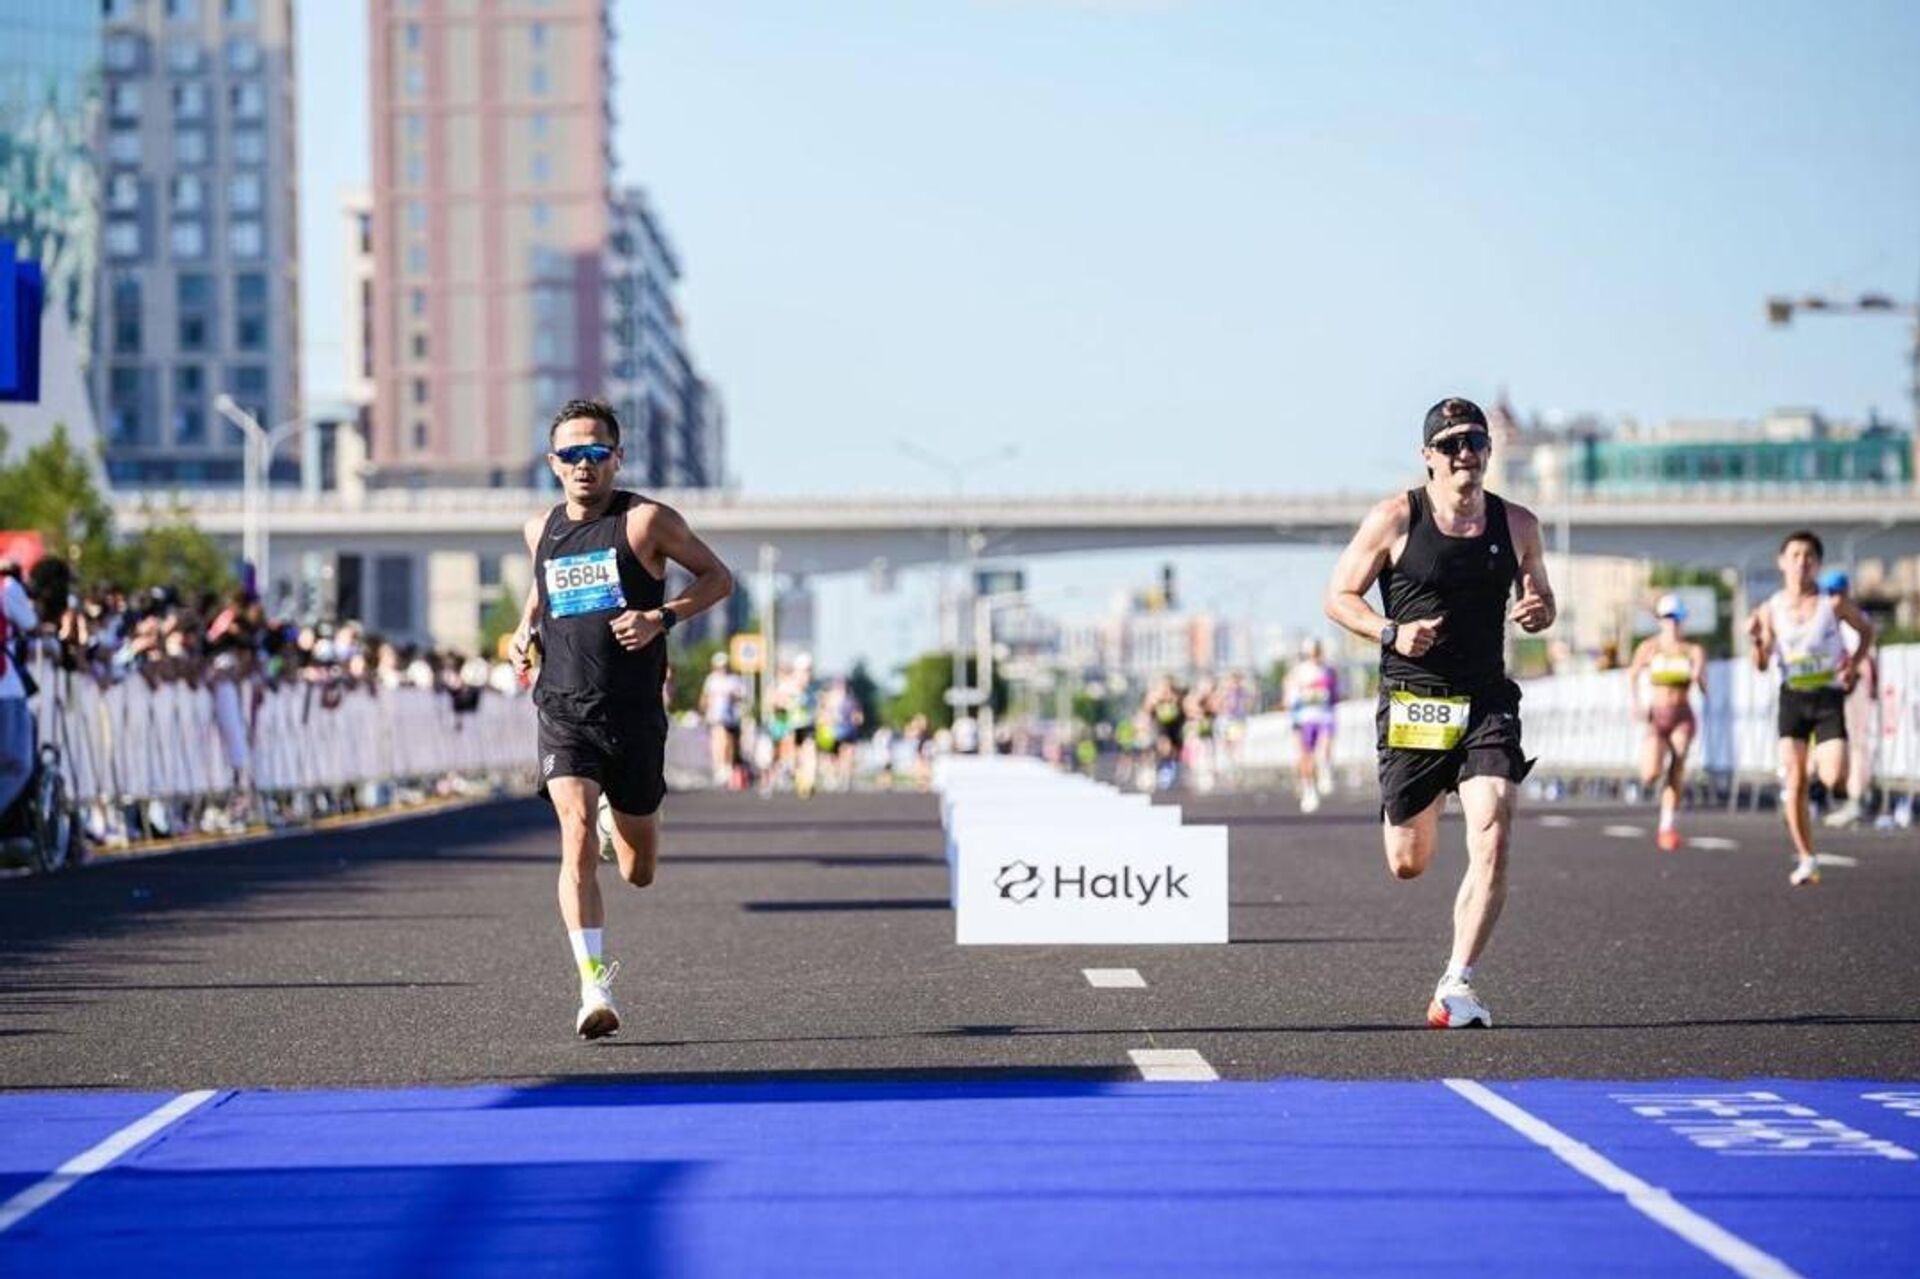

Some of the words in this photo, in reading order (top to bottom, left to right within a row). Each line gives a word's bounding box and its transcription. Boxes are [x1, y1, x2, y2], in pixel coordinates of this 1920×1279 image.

[555, 565, 610, 590] 5684
[1407, 702, 1452, 724] 688
[1054, 865, 1189, 906] Halyk
